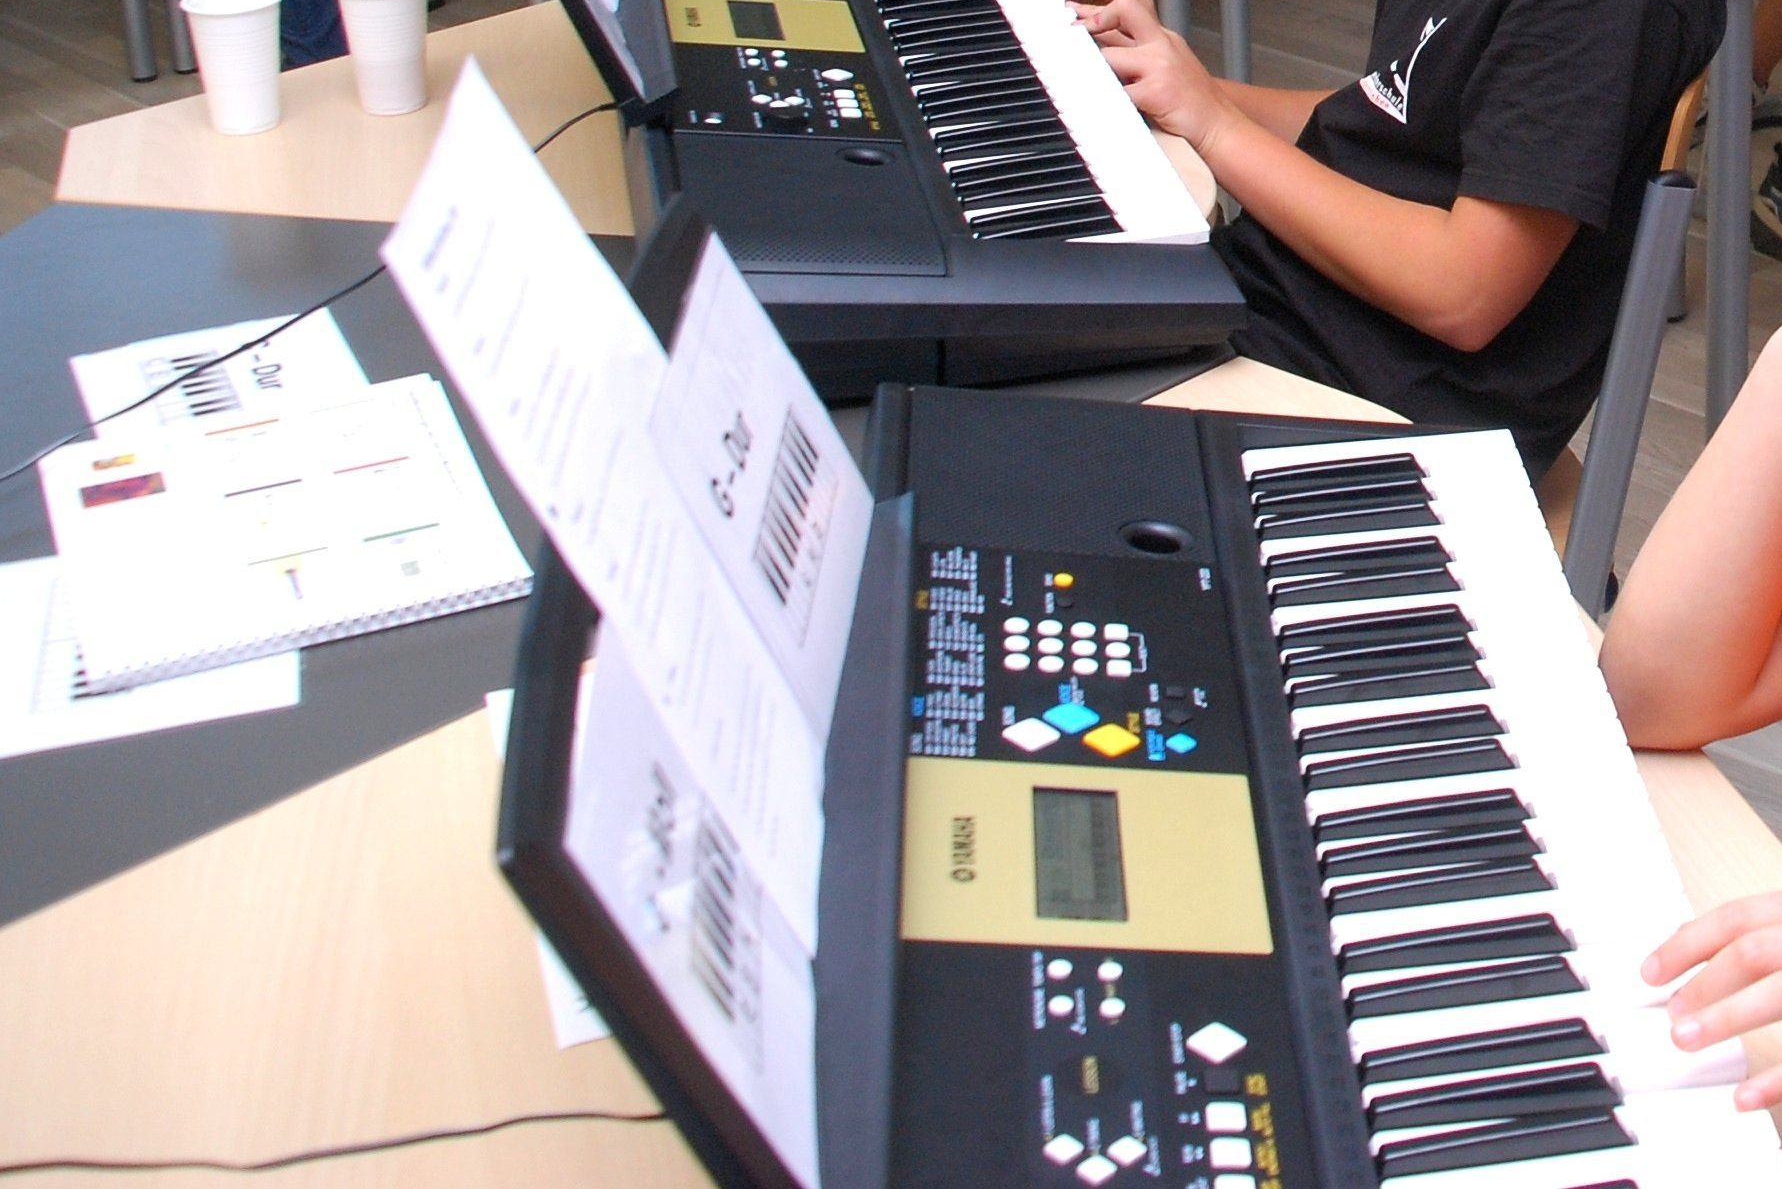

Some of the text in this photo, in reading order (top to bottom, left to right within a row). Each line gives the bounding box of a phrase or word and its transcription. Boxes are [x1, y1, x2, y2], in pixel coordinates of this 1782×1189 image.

[251, 363, 283, 390] Dur
[721, 409, 754, 471] Dur
[950, 815, 976, 866] YAMAHA
